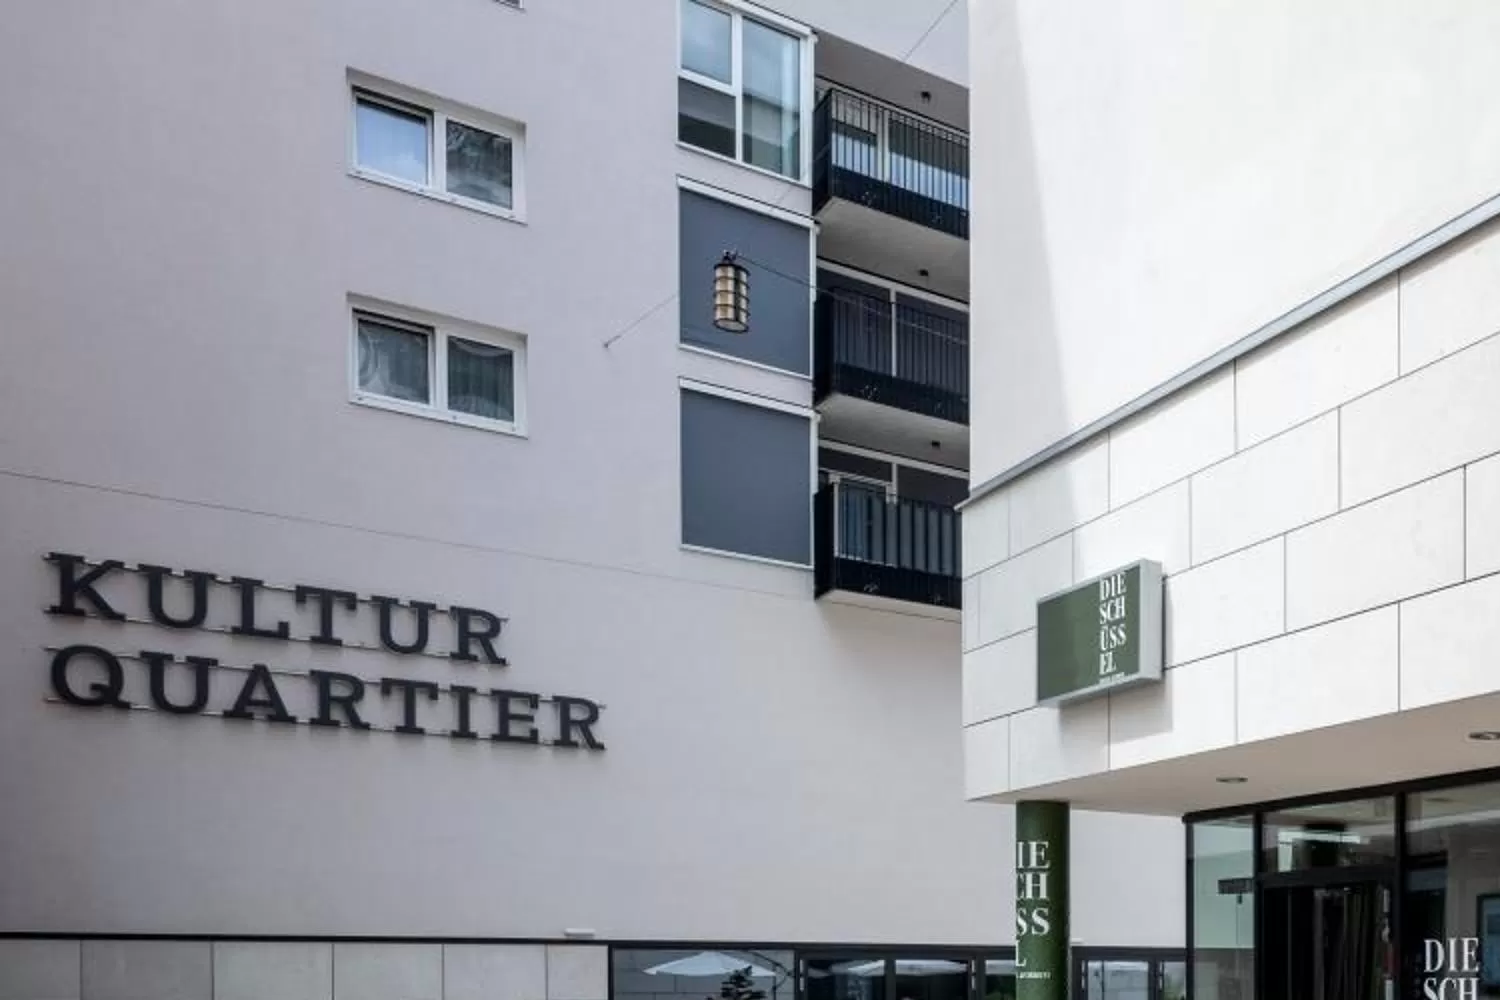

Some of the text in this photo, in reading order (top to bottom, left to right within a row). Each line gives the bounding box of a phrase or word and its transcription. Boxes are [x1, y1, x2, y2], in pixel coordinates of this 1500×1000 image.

[1100, 572, 1127, 600] DIE
[44, 552, 507, 665] KULTUR
[1100, 595, 1126, 625] SCH
[1100, 652, 1117, 675] EL
[50, 644, 606, 750] QUARTIER
[1016, 841, 1050, 869] IE
[1016, 908, 1050, 936] SS
[1015, 940, 1027, 967] L
[1424, 937, 1479, 973] DIE
